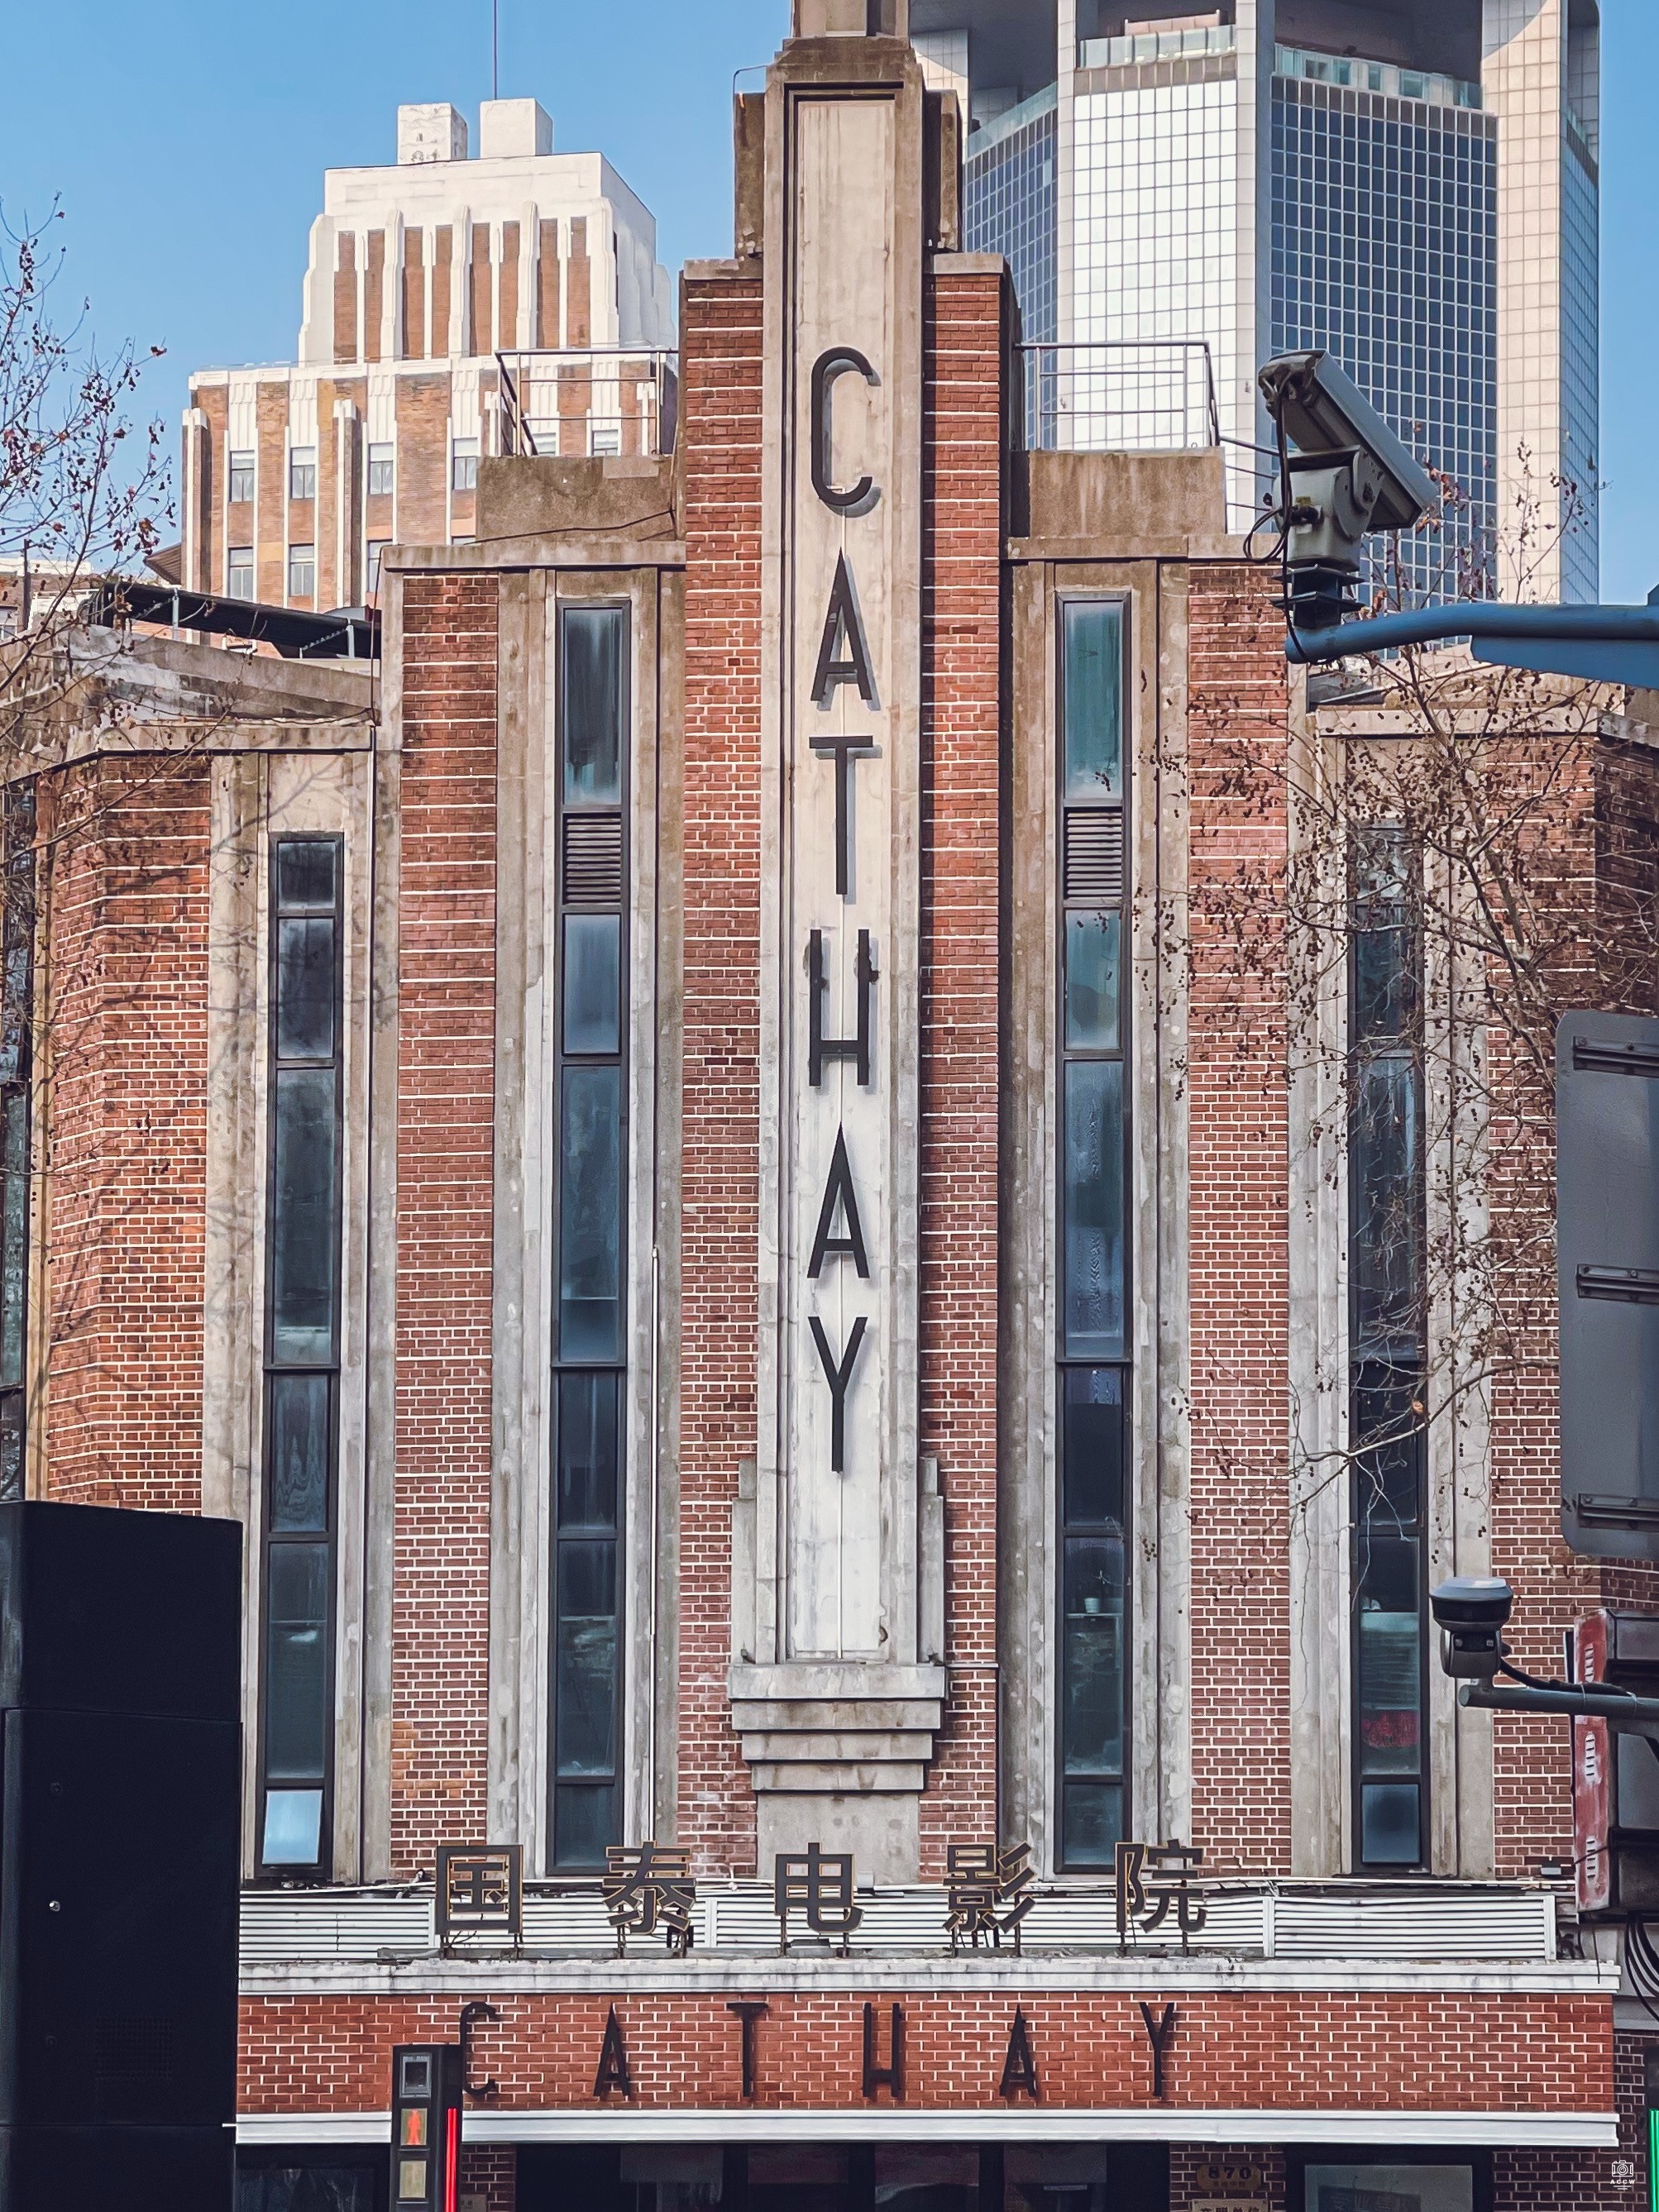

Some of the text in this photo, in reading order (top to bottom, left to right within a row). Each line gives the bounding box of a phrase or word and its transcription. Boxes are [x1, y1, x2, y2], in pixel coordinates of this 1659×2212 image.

[807, 346, 873, 1472] CATHAY
[435, 1839, 1207, 1934] 国泰电影院
[459, 2001, 1174, 2097] CATHAY
[1208, 2167, 1251, 2180] 870
